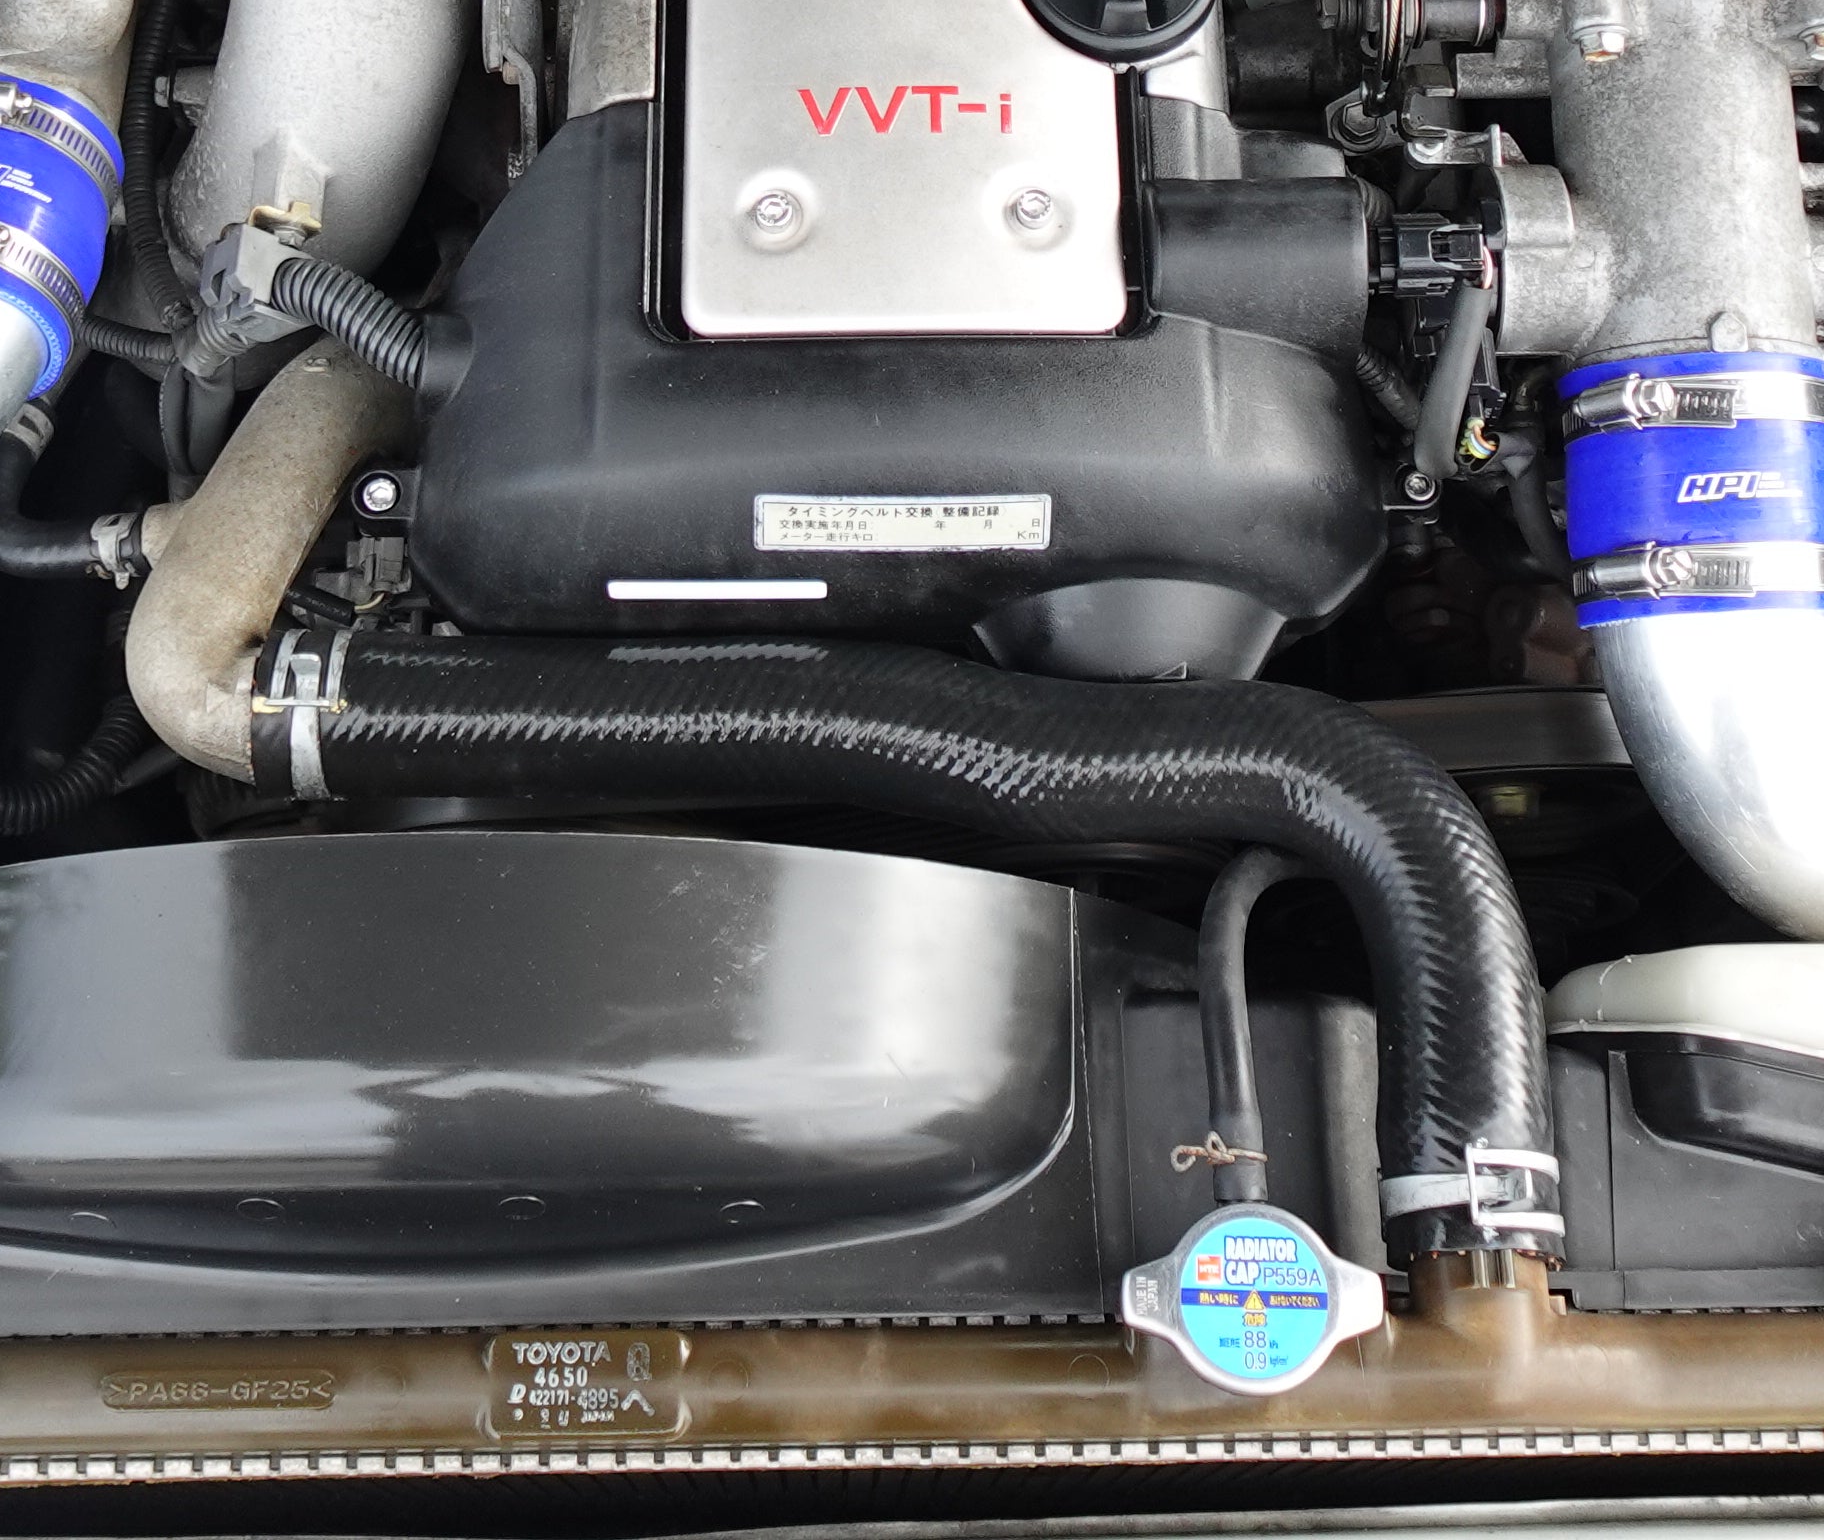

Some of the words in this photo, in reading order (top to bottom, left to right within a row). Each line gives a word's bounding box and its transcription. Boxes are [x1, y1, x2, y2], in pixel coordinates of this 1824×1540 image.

[796, 85, 1014, 137] VVT-i
[1676, 470, 1762, 504] HPI
[1016, 531, 1040, 540] Km
[1223, 1235, 1298, 1262] RADIATOR
[1223, 1260, 1262, 1287] CAP
[1262, 1267, 1322, 1287] P559A
[1244, 1330, 1267, 1349] 88
[511, 1340, 612, 1366] TOYOTA
[1244, 1351, 1267, 1370] 0.9
[533, 1366, 589, 1388] 4650
